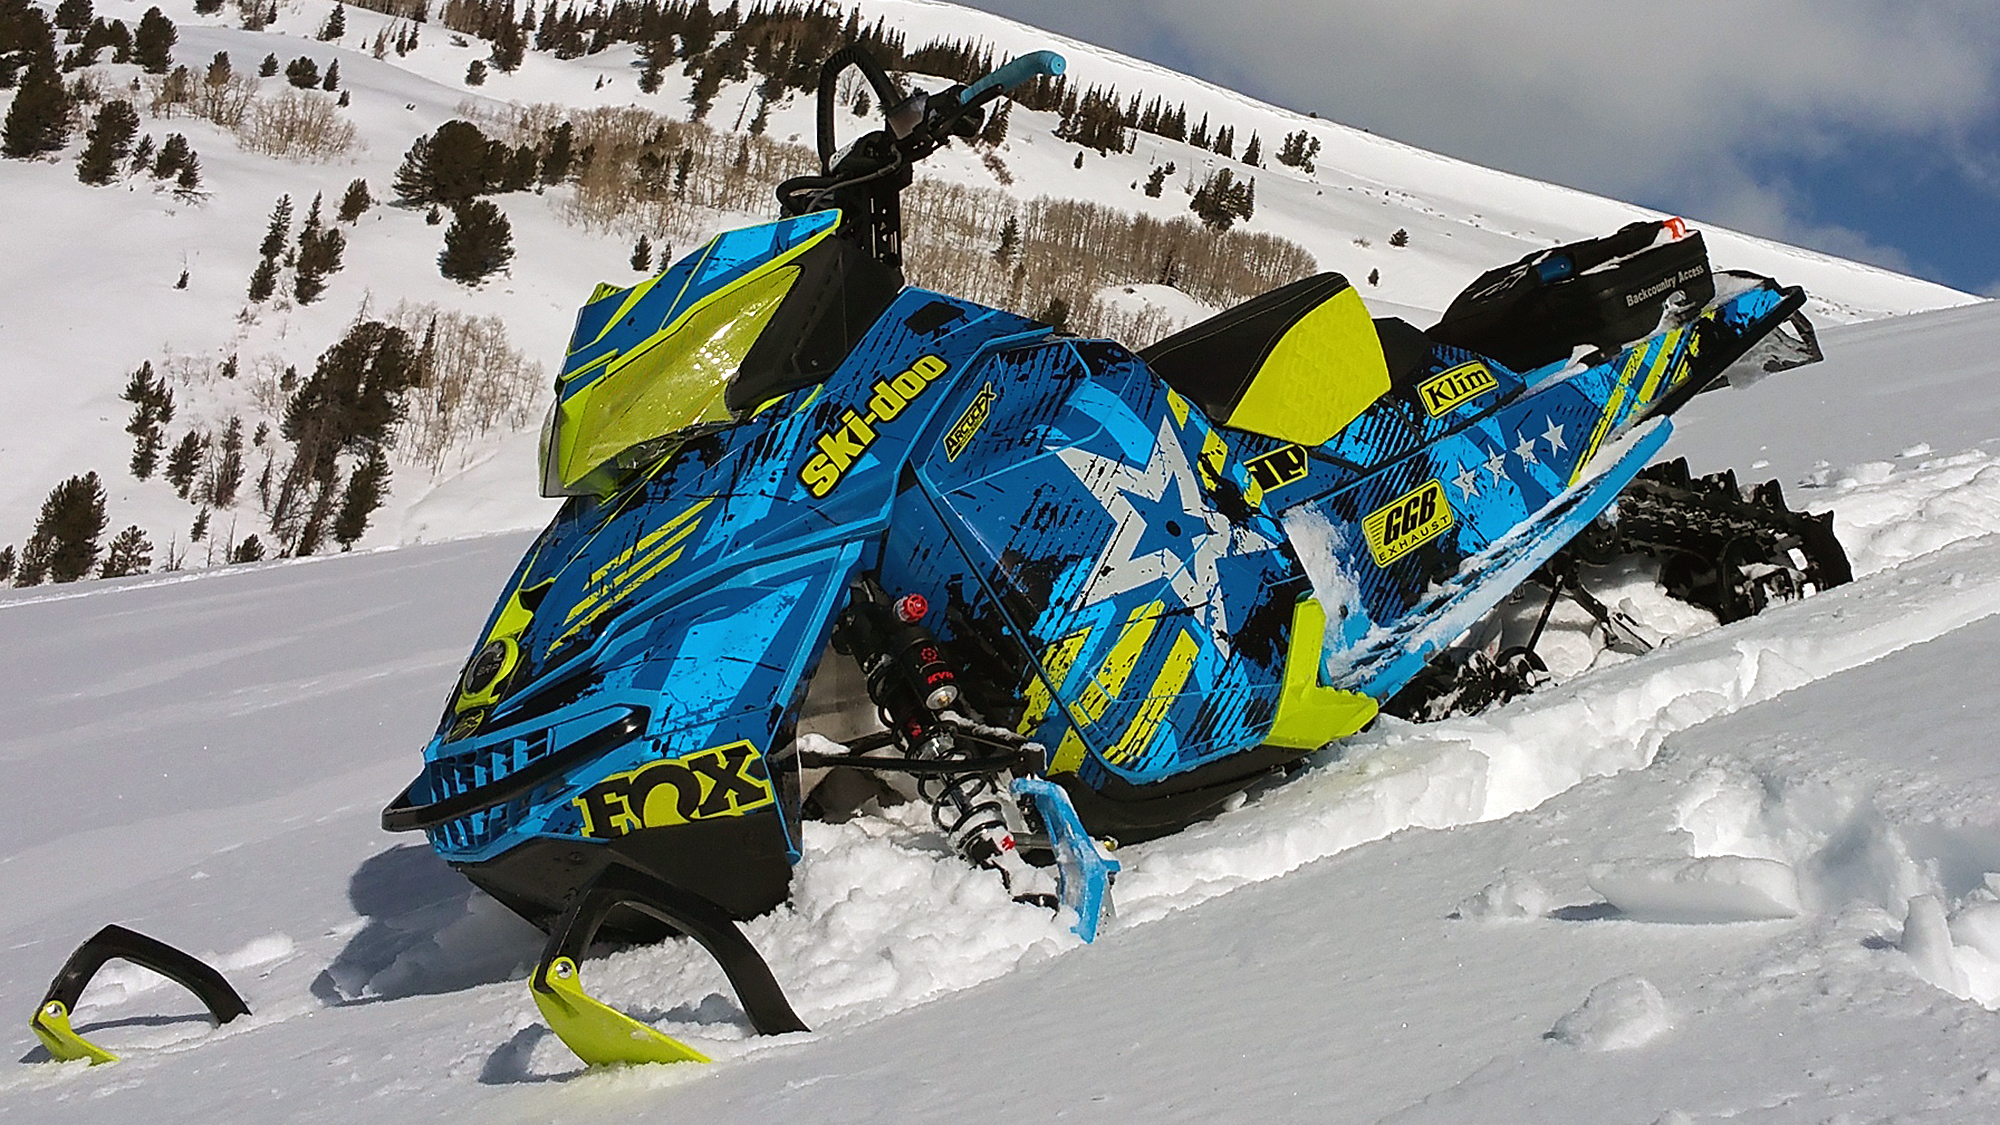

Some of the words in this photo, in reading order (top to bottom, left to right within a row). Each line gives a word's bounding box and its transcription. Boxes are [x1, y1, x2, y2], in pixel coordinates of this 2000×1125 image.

[1625, 275, 1677, 307] Backcountry
[1678, 264, 1705, 284] Access
[1425, 369, 1493, 411] Klim
[799, 354, 948, 498] ski-doo
[1378, 514, 1449, 561] EXHAUST
[1383, 486, 1438, 546] GGB
[574, 742, 771, 838] FOX
